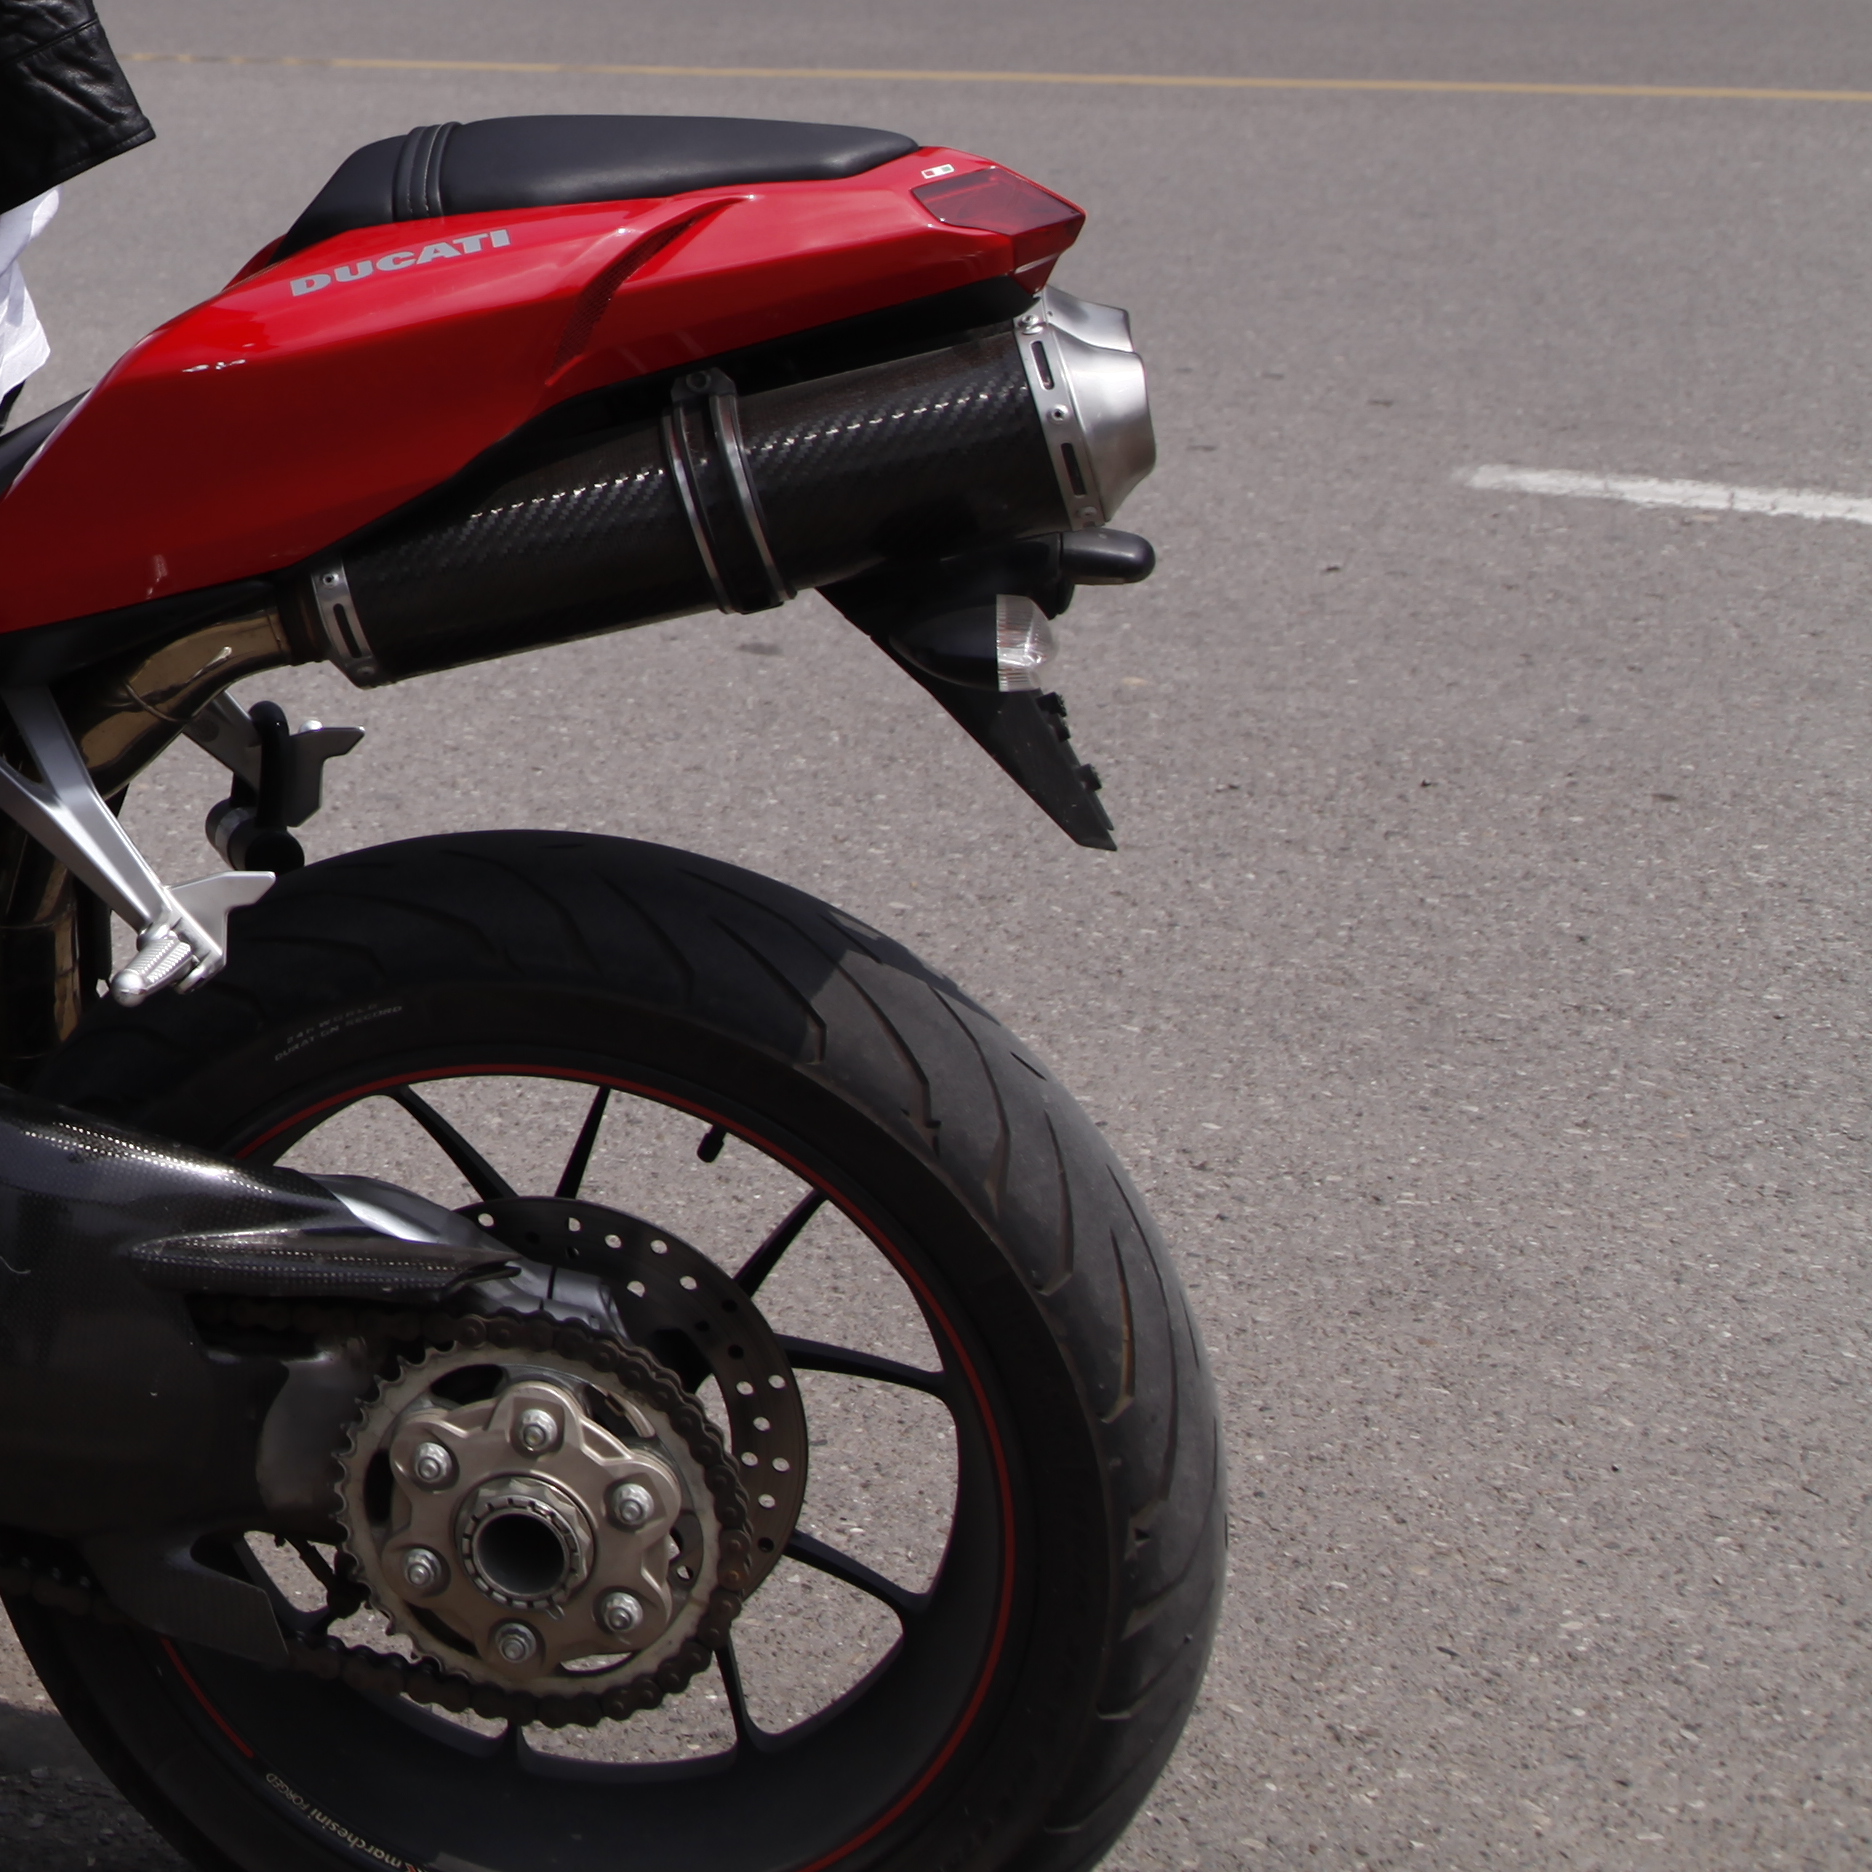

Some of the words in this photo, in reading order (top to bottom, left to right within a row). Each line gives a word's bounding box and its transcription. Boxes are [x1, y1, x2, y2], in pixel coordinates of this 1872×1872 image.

[290, 229, 510, 297] DUCATI
[265, 1771, 311, 1812] FORGED
[307, 1807, 403, 1870] marchesini
